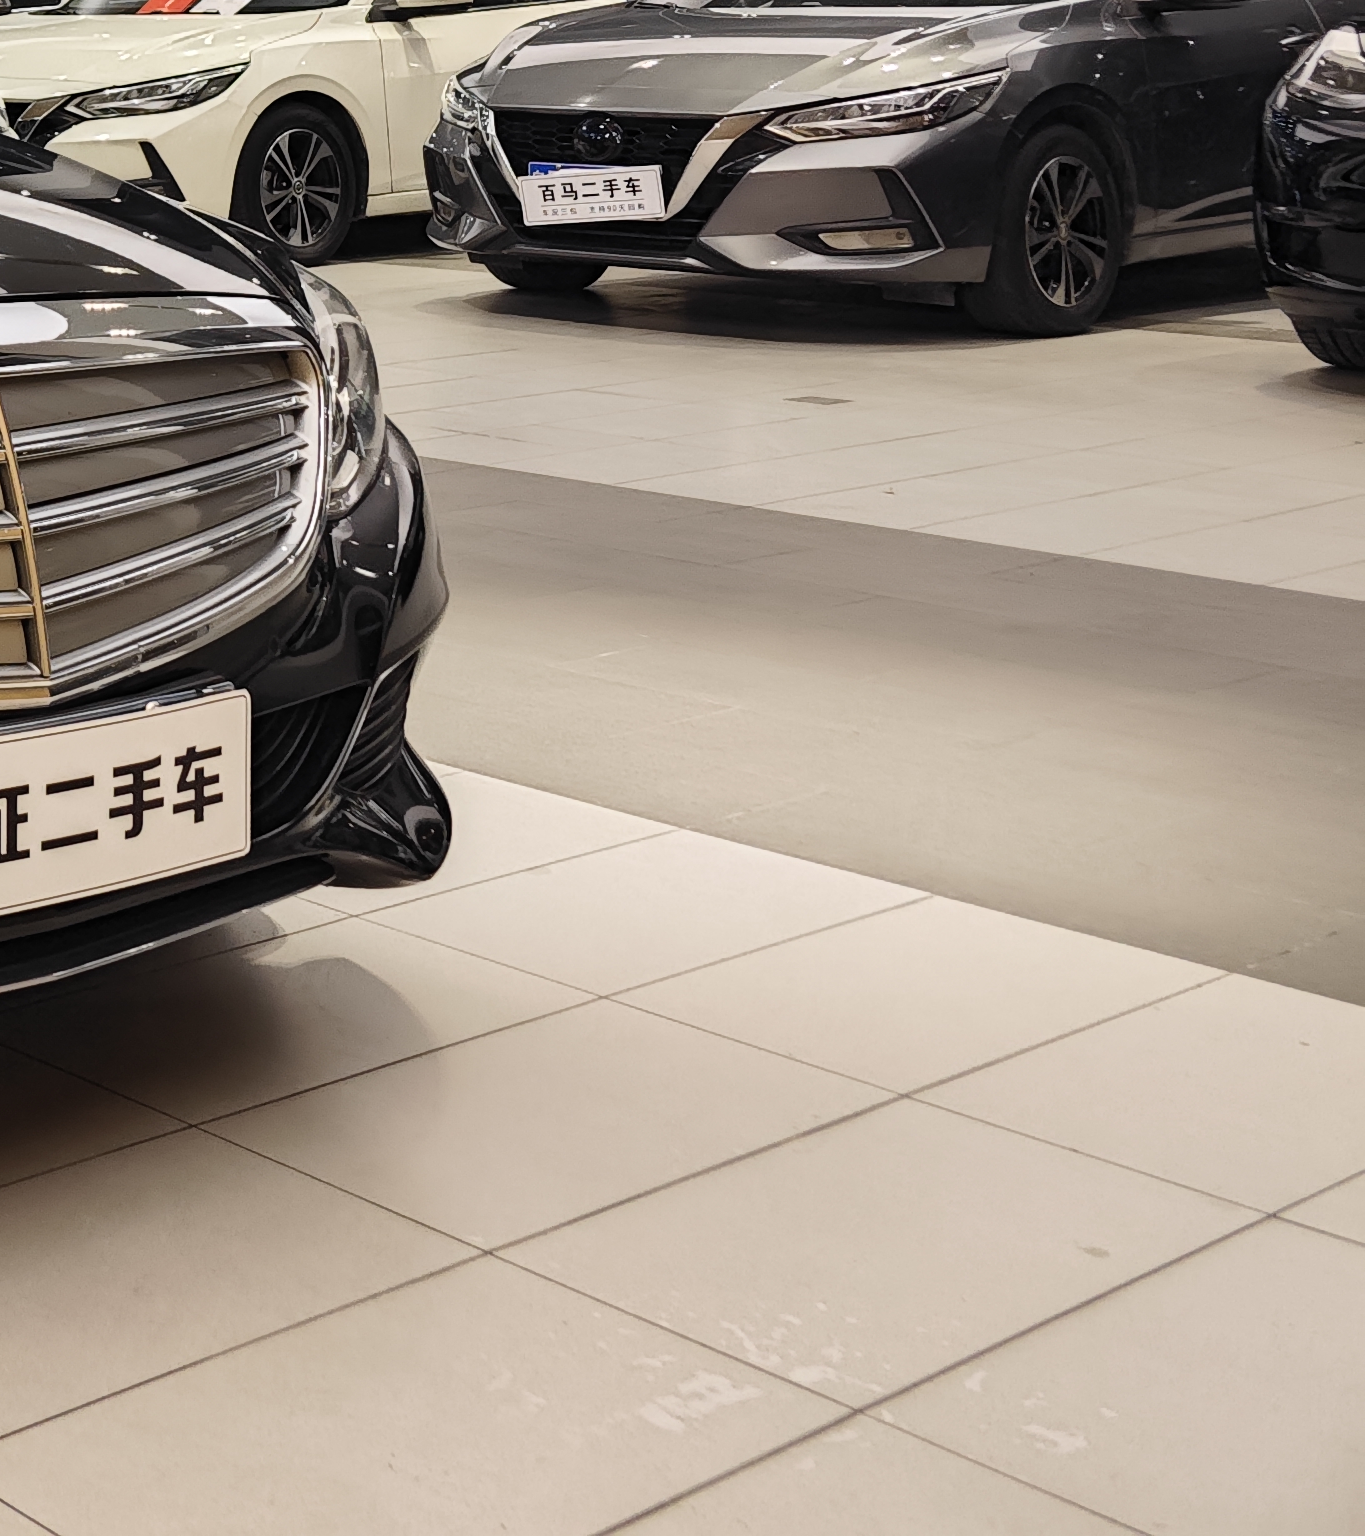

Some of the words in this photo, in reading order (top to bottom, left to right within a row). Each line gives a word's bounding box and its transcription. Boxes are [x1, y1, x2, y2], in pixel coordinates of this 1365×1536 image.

[537, 176, 643, 203] 百马二手车
